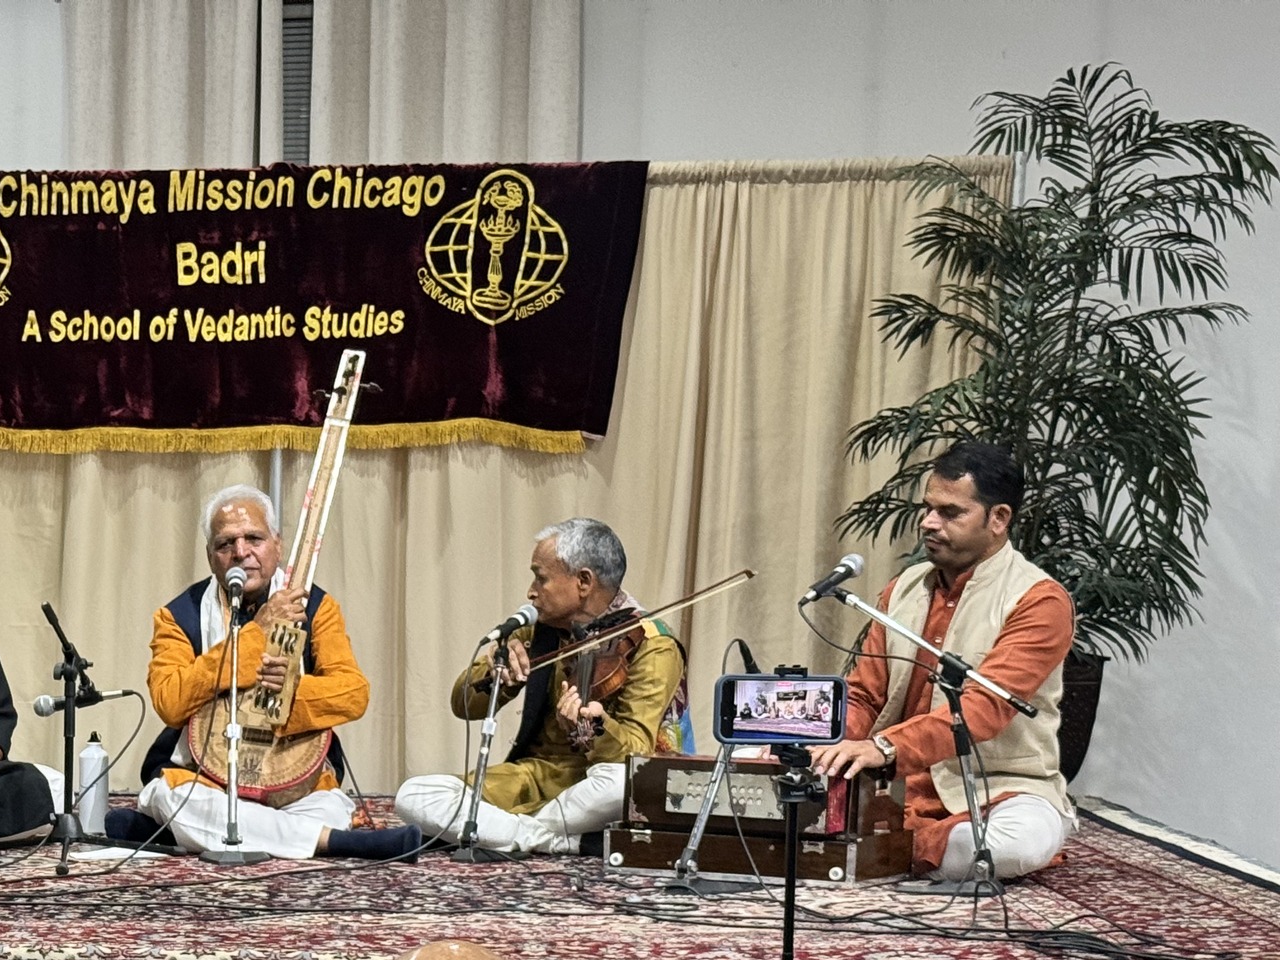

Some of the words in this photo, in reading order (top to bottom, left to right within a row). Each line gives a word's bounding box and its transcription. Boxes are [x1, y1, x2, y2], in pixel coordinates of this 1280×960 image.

[167, 169, 295, 213] Mission
[306, 166, 446, 217] Chicago
[176, 240, 267, 286] Badri
[416, 266, 466, 315] CHINMAYA
[514, 283, 566, 322] MISSION
[21, 309, 42, 343] A
[48, 308, 141, 343] School
[148, 307, 179, 343] of
[183, 305, 297, 343] Vedantic
[302, 303, 406, 342] Studies
